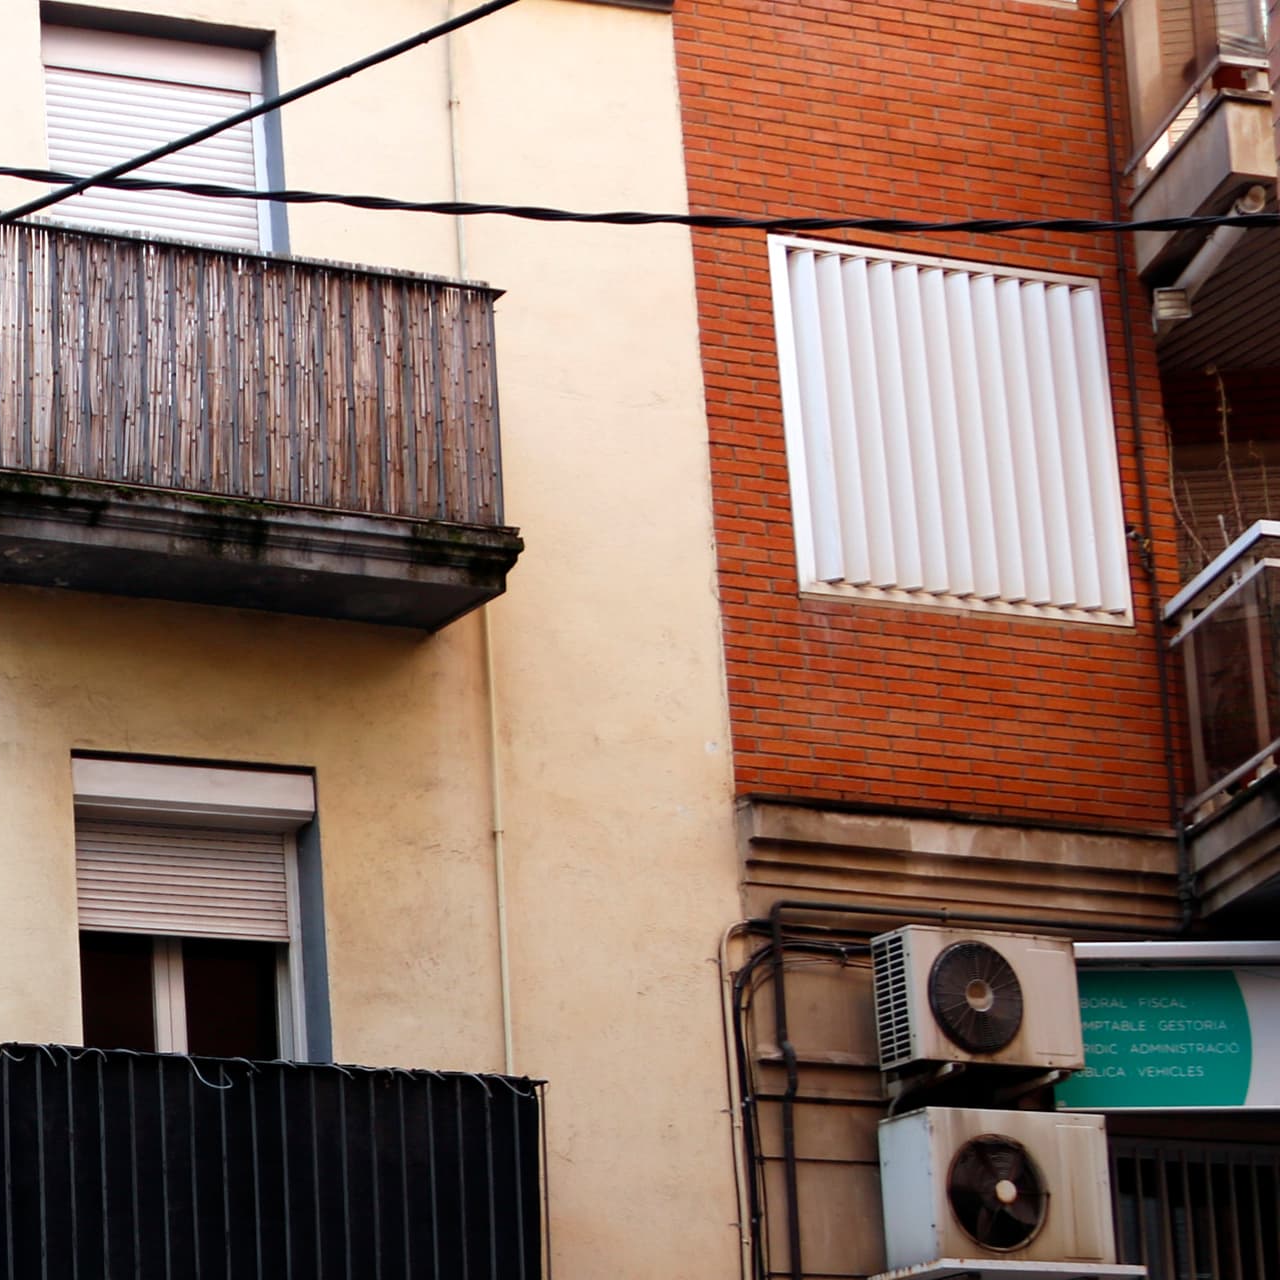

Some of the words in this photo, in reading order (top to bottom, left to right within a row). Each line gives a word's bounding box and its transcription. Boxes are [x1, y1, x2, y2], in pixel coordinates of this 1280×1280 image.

[1138, 997, 1187, 1009] FISCAL
[1157, 1019, 1228, 1032] GESTORIA
[1137, 1065, 1205, 1078] VEHICLES
